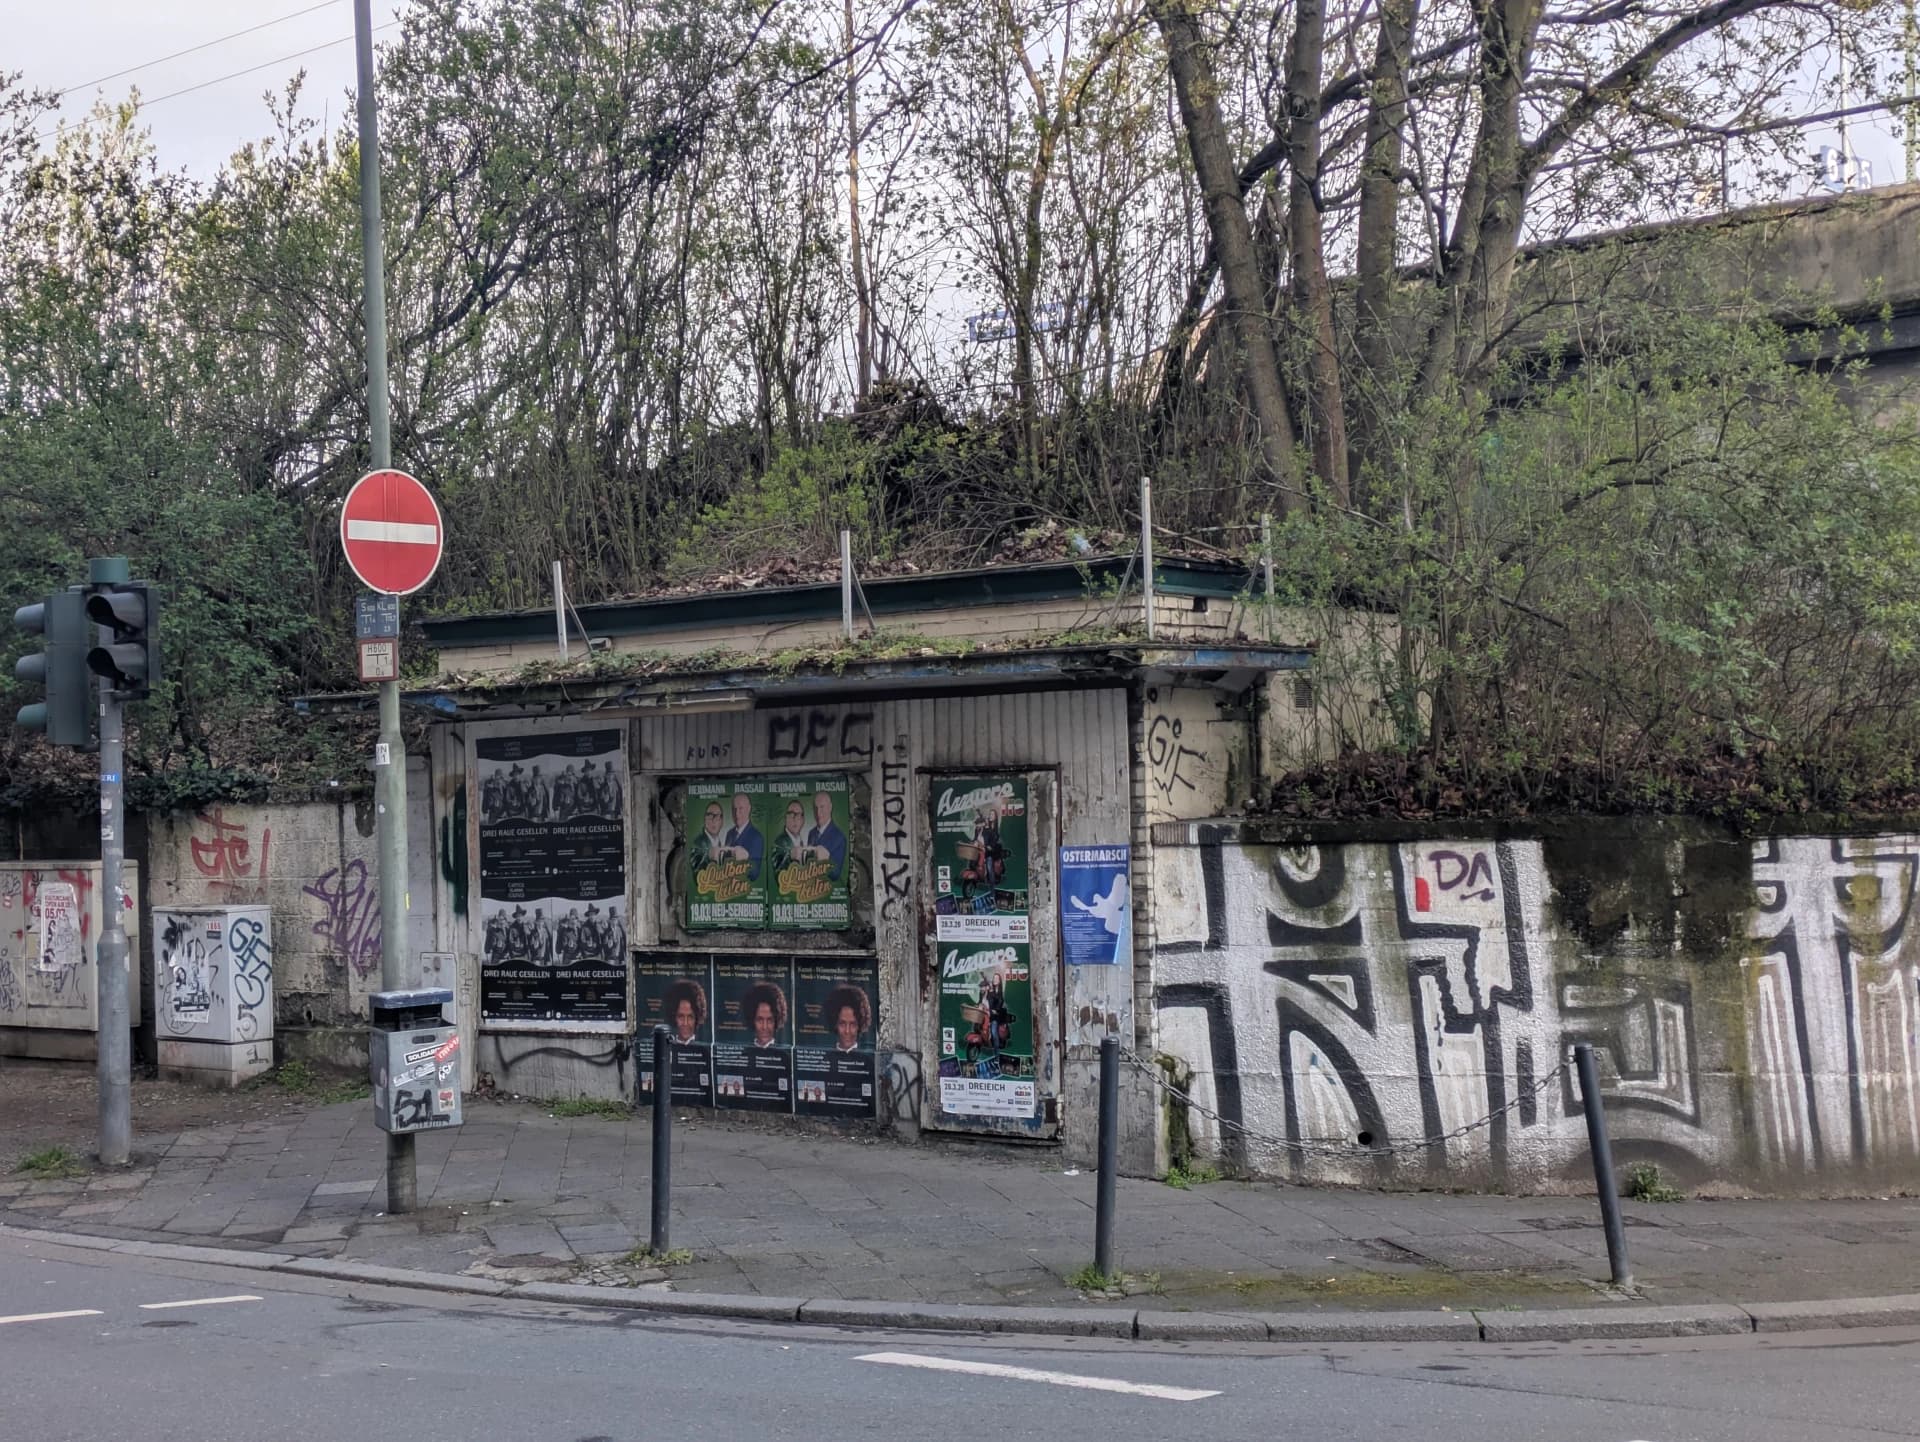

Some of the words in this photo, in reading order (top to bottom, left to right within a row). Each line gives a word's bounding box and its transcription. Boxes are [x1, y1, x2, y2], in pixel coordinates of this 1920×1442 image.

[482, 829, 497, 837] DREI
[499, 829, 515, 837] RAUE
[517, 827, 548, 836] GESELLEN
[552, 827, 568, 835] DREI
[569, 826, 587, 834] RAUE
[588, 824, 622, 833] GESELLEN
[1063, 848, 1127, 863] OSTERMARSCH
[711, 903, 763, 917] NEU-ISENBURG
[793, 904, 848, 918] NEU-ISENBURG
[965, 918, 1000, 928] DREIEICH
[501, 970, 517, 978] RAUE
[519, 970, 550, 978] GESELLEN
[556, 970, 571, 978] DREI
[573, 970, 590, 978] RAUE
[592, 970, 625, 978] GESELLEN
[968, 1081, 1006, 1092] DREIEICH
